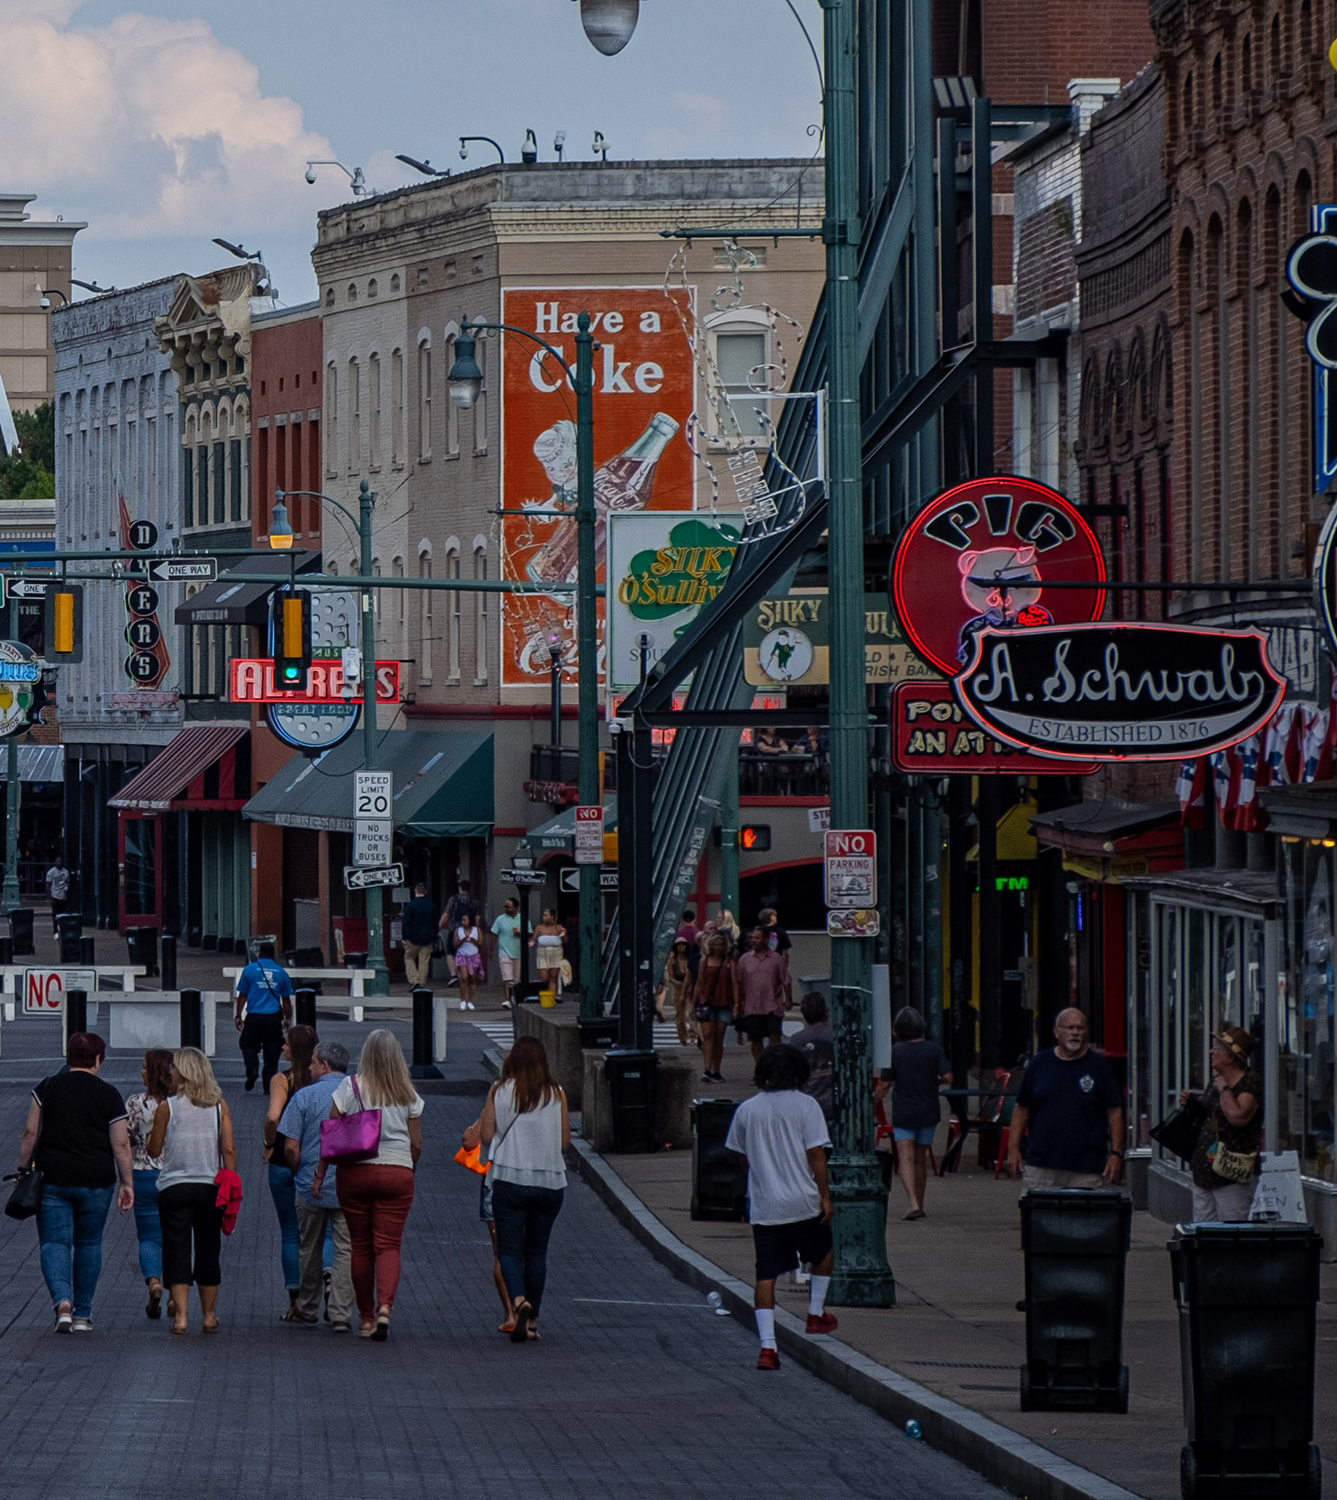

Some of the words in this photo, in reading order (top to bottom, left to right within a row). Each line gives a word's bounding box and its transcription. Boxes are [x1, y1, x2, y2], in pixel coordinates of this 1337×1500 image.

[535, 302, 624, 333] Have
[639, 311, 661, 333] a
[922, 494, 1077, 552] PIG
[169, 566, 188, 575] ONE
[190, 565, 210, 575] WAY
[618, 571, 724, 605] O'Sulliv
[19, 605, 41, 615] THE
[757, 600, 821, 632] SILKY
[866, 665, 899, 677] RISH
[1043, 638, 1265, 703] Schwab
[1028, 718, 1162, 743] ESTABLISHED
[1170, 719, 1209, 739] 1876
[908, 730, 946, 754] AN
[358, 777, 389, 785] SPEED
[361, 786, 385, 794] LIMIT
[358, 796, 388, 812] 20
[579, 809, 598, 819] NO
[357, 834, 390, 842] TRUCKS
[835, 835, 866, 853] NO
[359, 853, 386, 862] BUSES
[830, 860, 869, 870] PARKING
[364, 872, 380, 882] ONE
[381, 870, 397, 880] WAY
[29, 974, 62, 1008] NO
